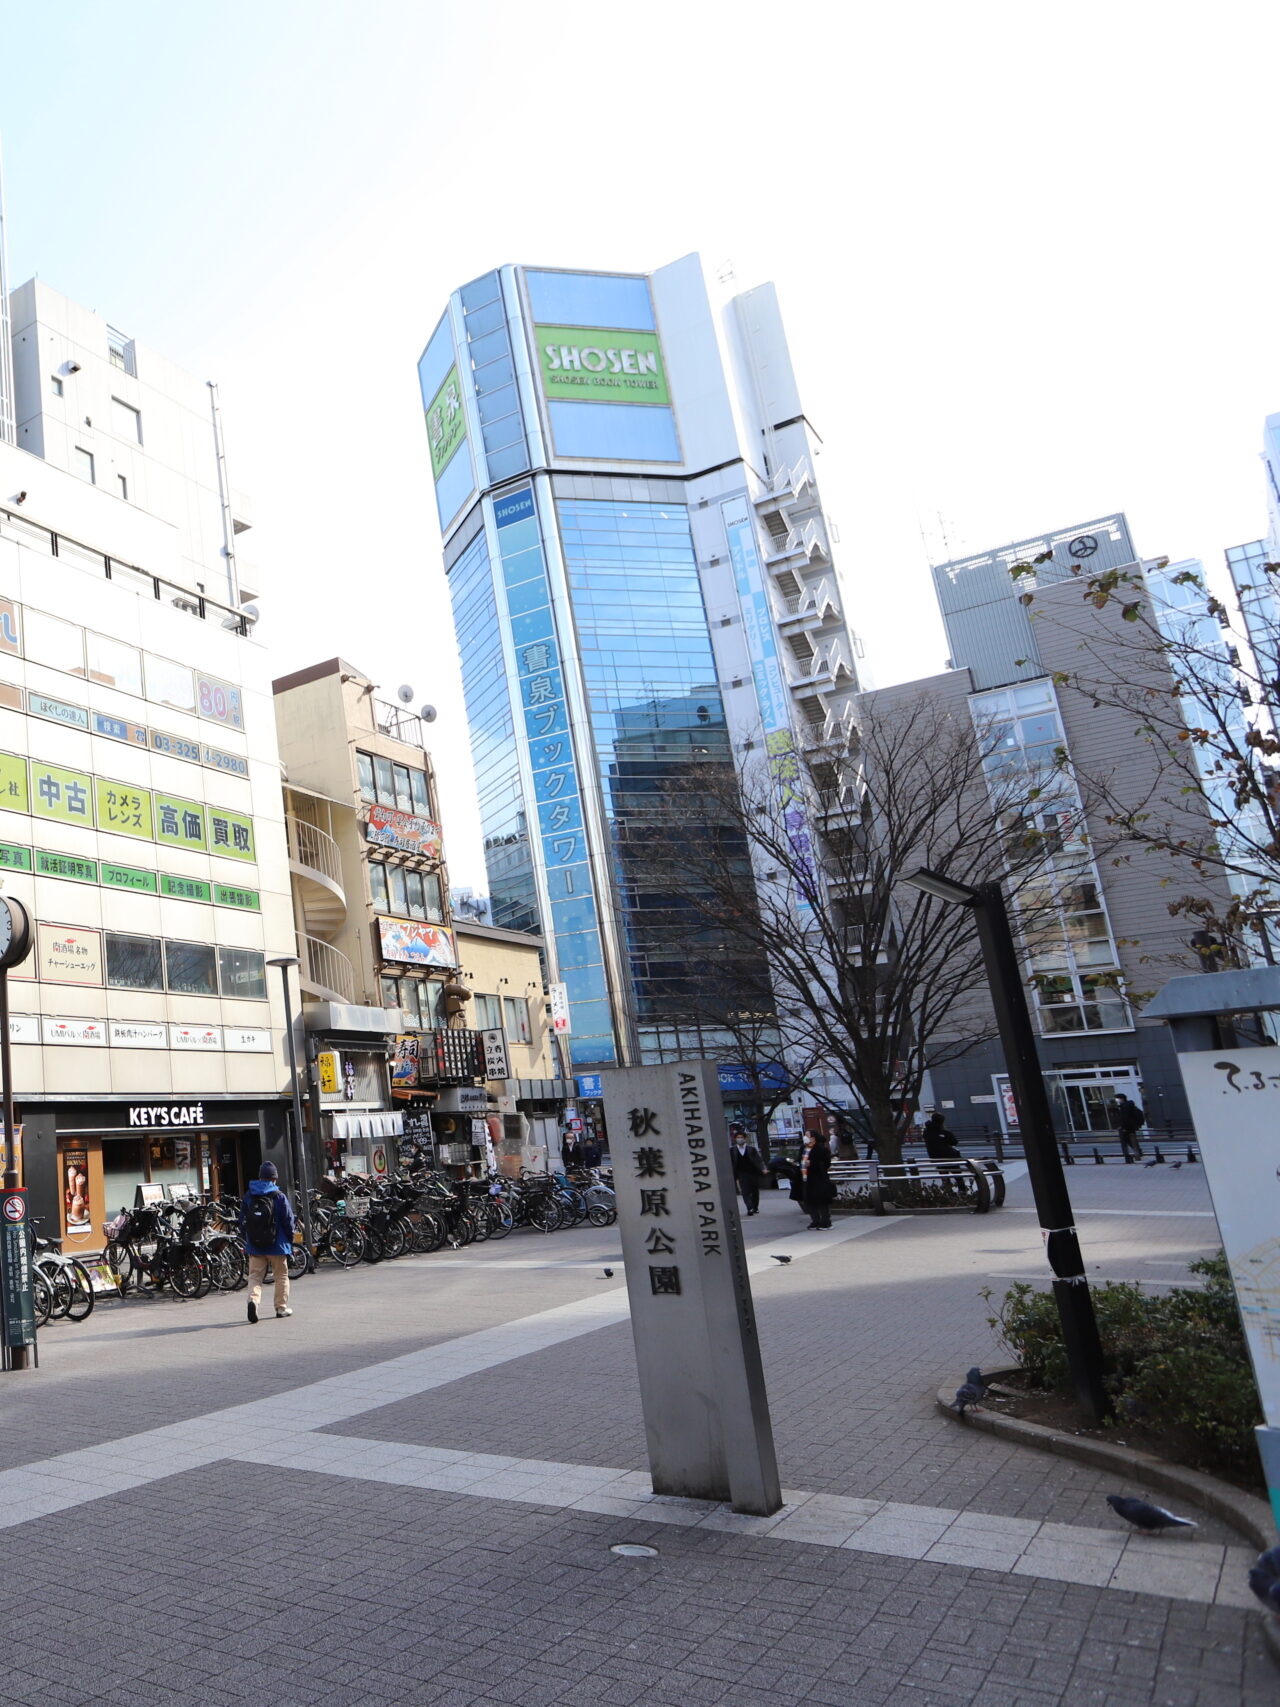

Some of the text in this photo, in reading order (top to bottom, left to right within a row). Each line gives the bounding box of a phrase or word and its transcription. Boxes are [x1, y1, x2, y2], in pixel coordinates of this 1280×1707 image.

[544, 343, 657, 376] SHOSEN
[550, 374, 659, 390] SHOSEN BOOK TOWER
[497, 499, 532, 519] SHOSEN
[40, 701, 85, 725] ほぐしの達人
[522, 643, 577, 894] 書泉ブックタワー
[38, 774, 88, 816] 中古
[105, 789, 141, 811] カメラ
[107, 807, 144, 829] レンズ
[158, 803, 251, 854] 高価買取
[40, 854, 94, 880] 就活証明写真
[108, 868, 150, 889] プロフィール
[167, 880, 204, 899] 記念撮影
[6, 920, 12, 931] 3
[399, 1038, 420, 1060] 寿司
[129, 1102, 204, 1126] KEY'S CAFÉ
[677, 1072, 722, 1257] AKIHABARA PARK
[626, 1106, 682, 1296] 秋葉原公園
